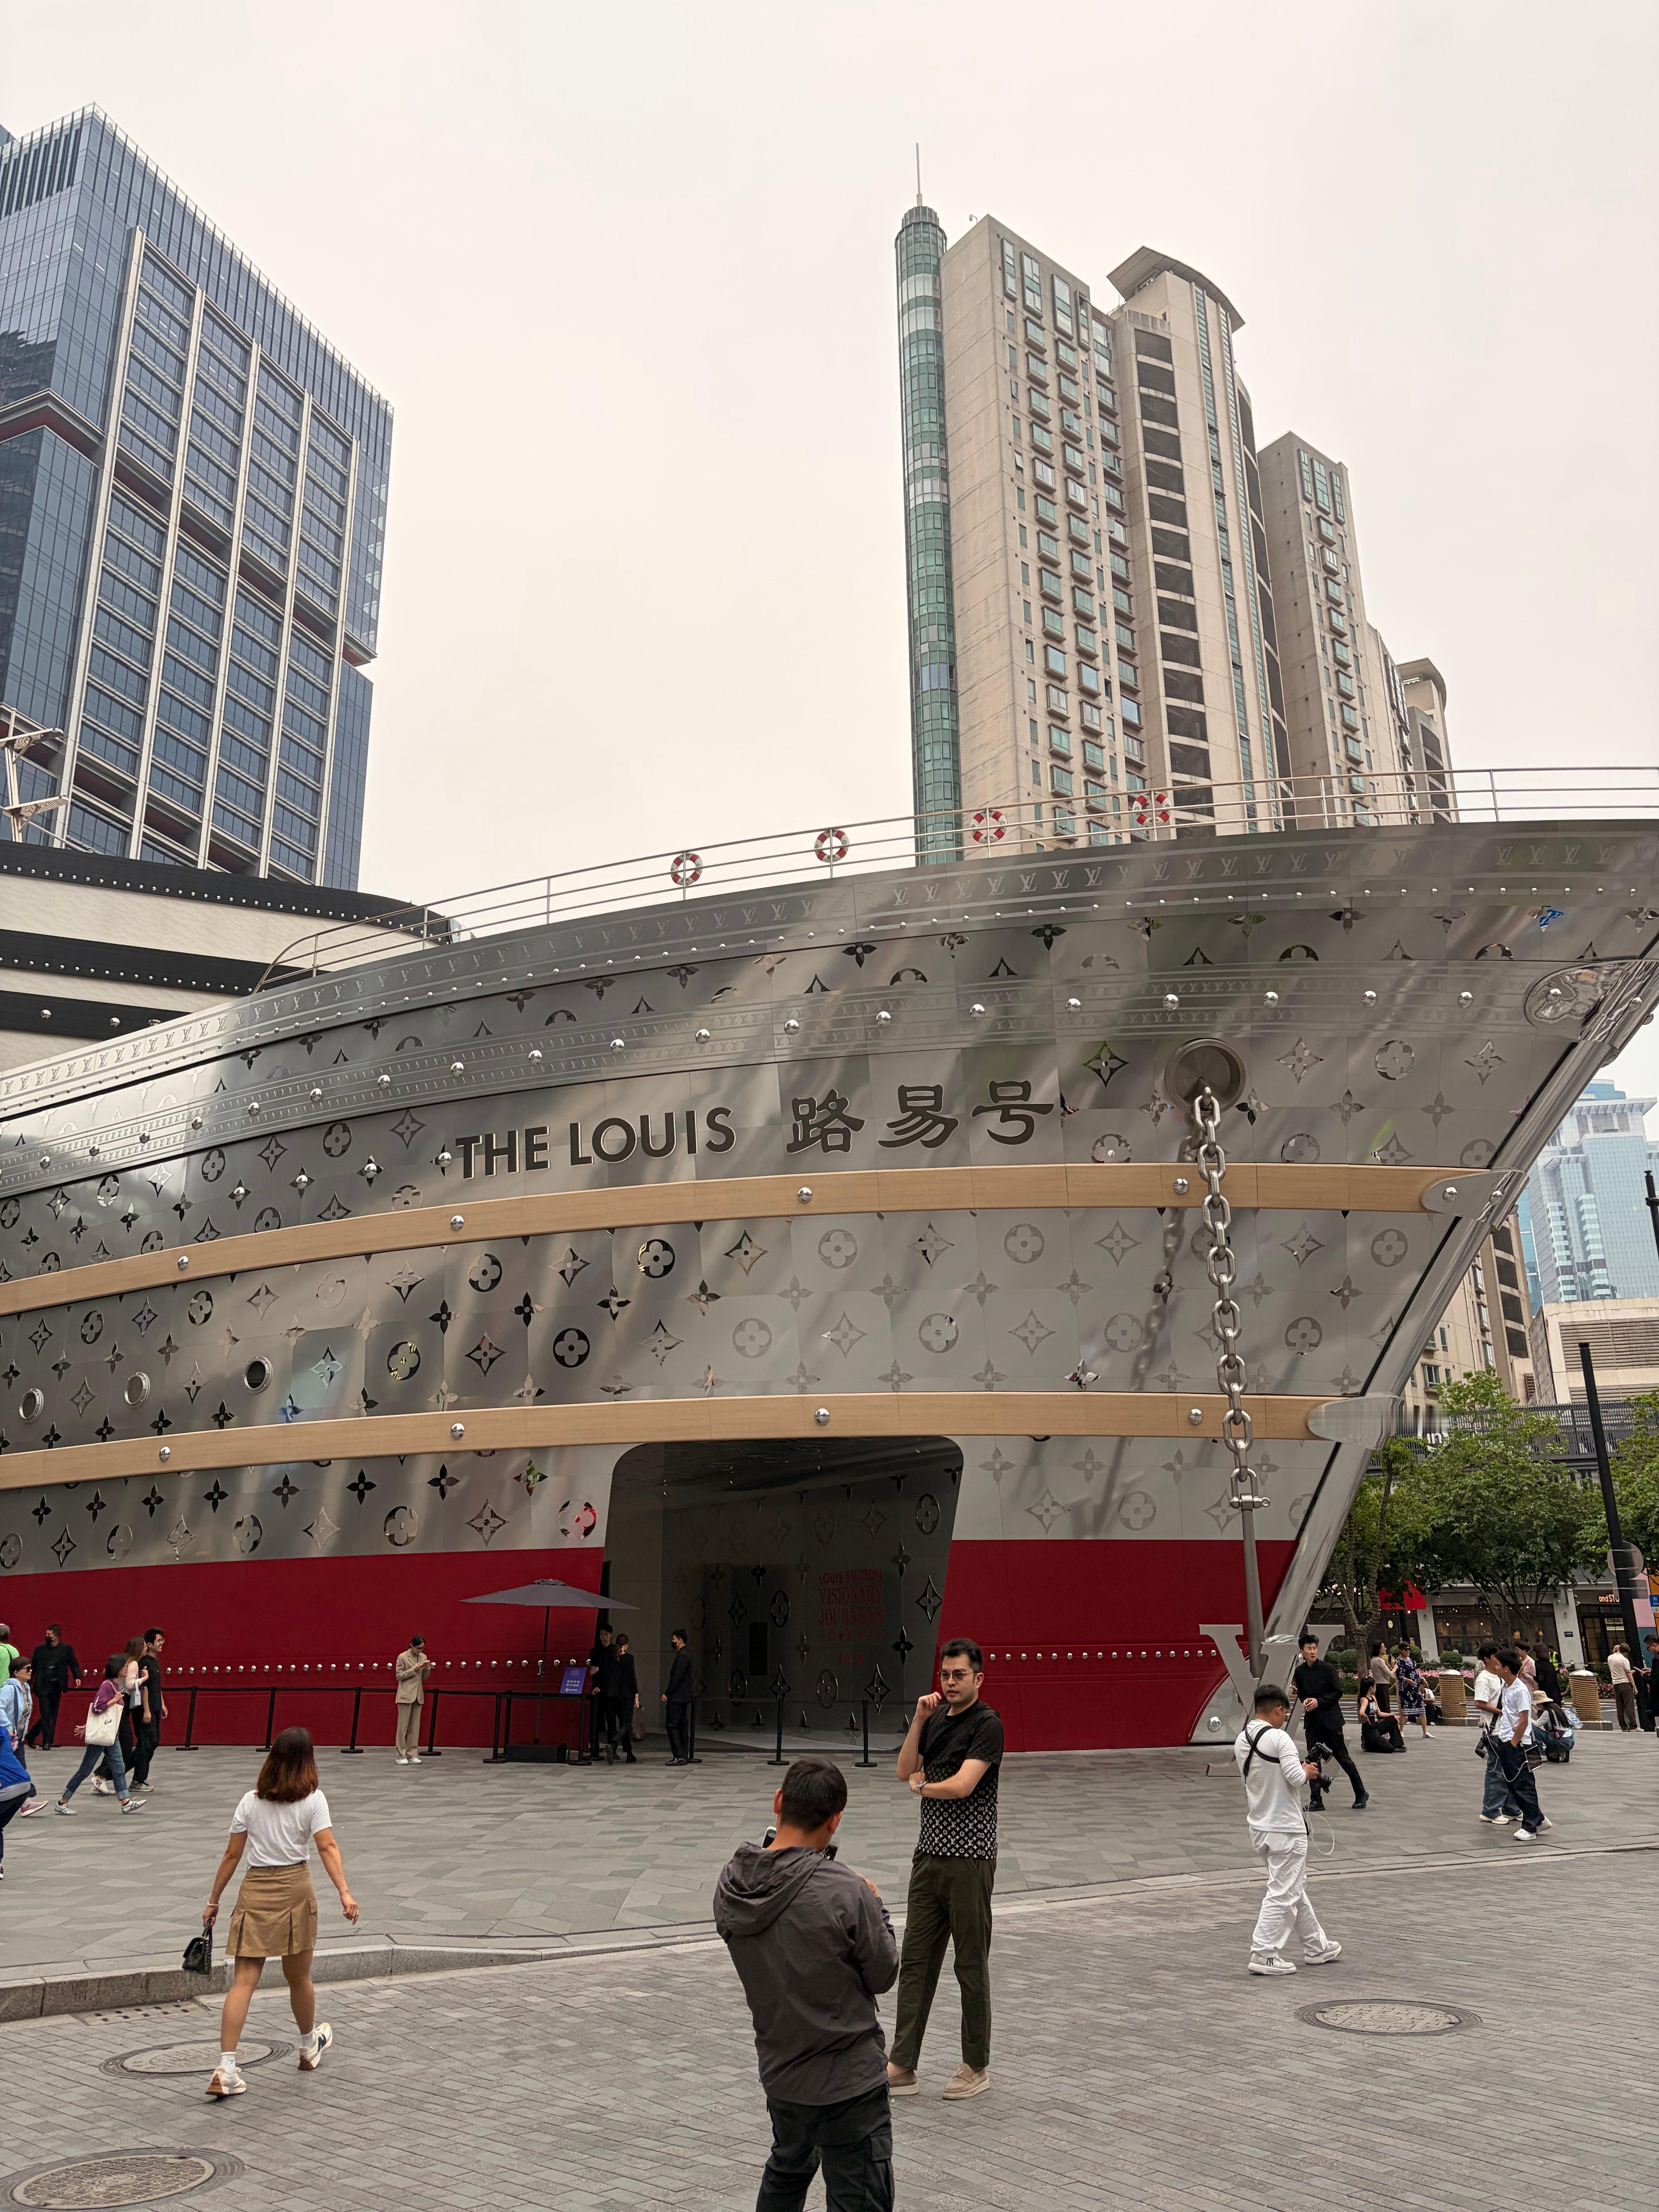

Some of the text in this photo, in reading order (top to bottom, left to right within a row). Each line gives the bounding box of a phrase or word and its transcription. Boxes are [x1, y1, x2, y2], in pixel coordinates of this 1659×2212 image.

[5, 1081, 14, 1095] LV
[21, 1076, 29, 1090] LV
[35, 1072, 45, 1086] LV
[50, 1067, 60, 1081] LV
[66, 1063, 76, 1077] LV
[82, 1058, 92, 1072] LV
[99, 1053, 108, 1067] LV
[115, 1048, 124, 1063] LV
[132, 1043, 141, 1058] LV
[148, 1038, 158, 1053] LV
[165, 1032, 175, 1047] LV
[182, 1027, 192, 1042] LV
[199, 1021, 210, 1037] LV
[218, 1016, 228, 1031] LV
[235, 1011, 245, 1026] LV
[254, 1005, 264, 1021] LV
[273, 1000, 283, 1015] LV
[293, 994, 304, 1010] LV
[314, 989, 324, 1005] LV
[334, 984, 345, 1000] LV
[685, 915, 699, 932] LV
[713, 912, 728, 928] LV
[742, 907, 757, 925] LV
[771, 903, 787, 920] LV
[893, 888, 908, 905] LV
[924, 884, 940, 902] LV
[956, 881, 972, 898] LV
[987, 877, 1004, 895] LV
[1019, 874, 1036, 892] LV
[1051, 871, 1069, 889] LV
[1084, 867, 1102, 886] LV
[1117, 865, 1134, 884] LV
[1151, 862, 1169, 881] LV
[1186, 860, 1203, 879] LV
[1220, 857, 1238, 876] LV
[1255, 855, 1273, 874] LV
[1289, 854, 1307, 872] LV
[1324, 852, 1342, 870] LV
[1359, 850, 1376, 868] LV
[1393, 848, 1410, 867] LV
[1496, 847, 1513, 865] LV
[1528, 846, 1546, 864] LV
[1562, 845, 1582, 864] LV
[1595, 845, 1614, 864] LV
[787, 1080, 1054, 1153] 路易号
[455, 1107, 736, 1179] THE LOUIS
[819, 1568, 882, 1584] LOUIS VUITTON
[819, 1585, 883, 1604] VISIONARY
[819, 1606, 883, 1626] JOURNEYS
